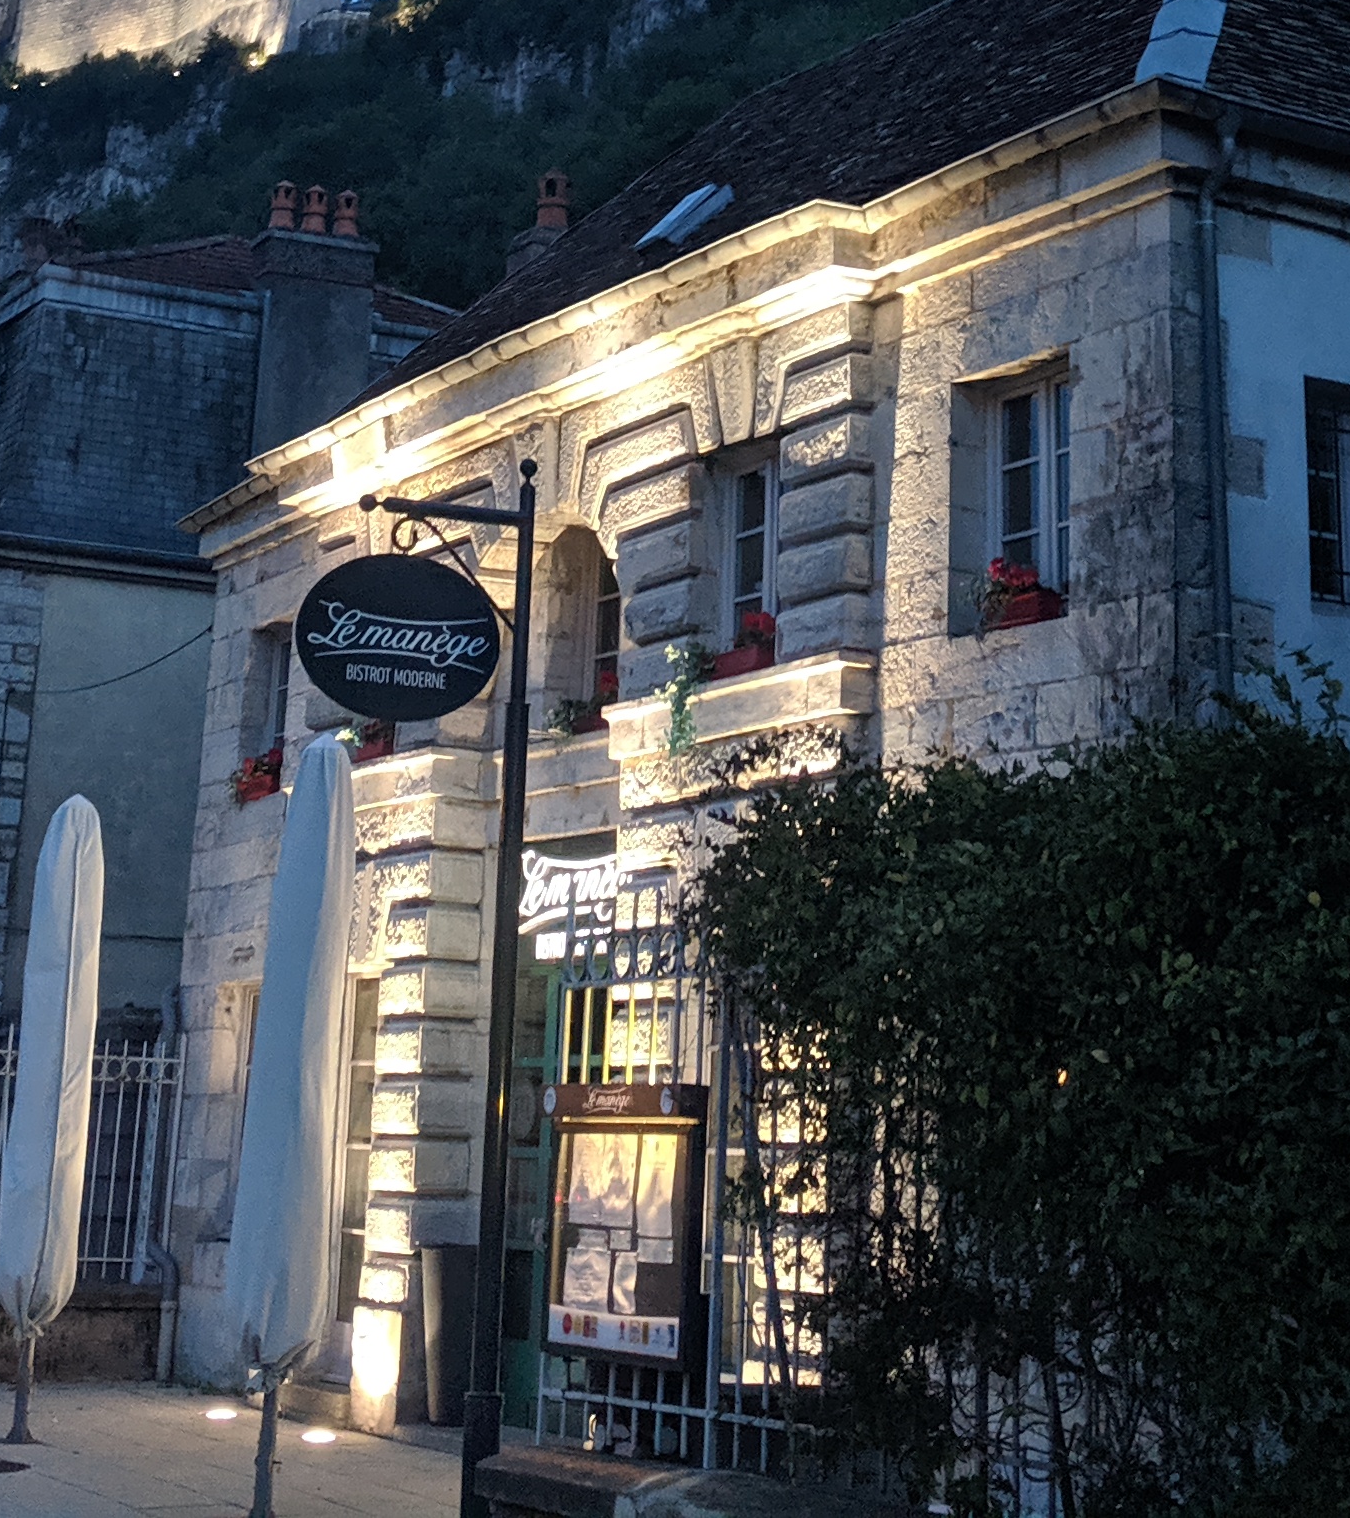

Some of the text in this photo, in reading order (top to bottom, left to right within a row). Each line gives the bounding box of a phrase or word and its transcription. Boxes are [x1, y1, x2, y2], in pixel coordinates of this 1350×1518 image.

[307, 599, 491, 668] Le manège
[345, 662, 447, 690] BISTROT MODERNE
